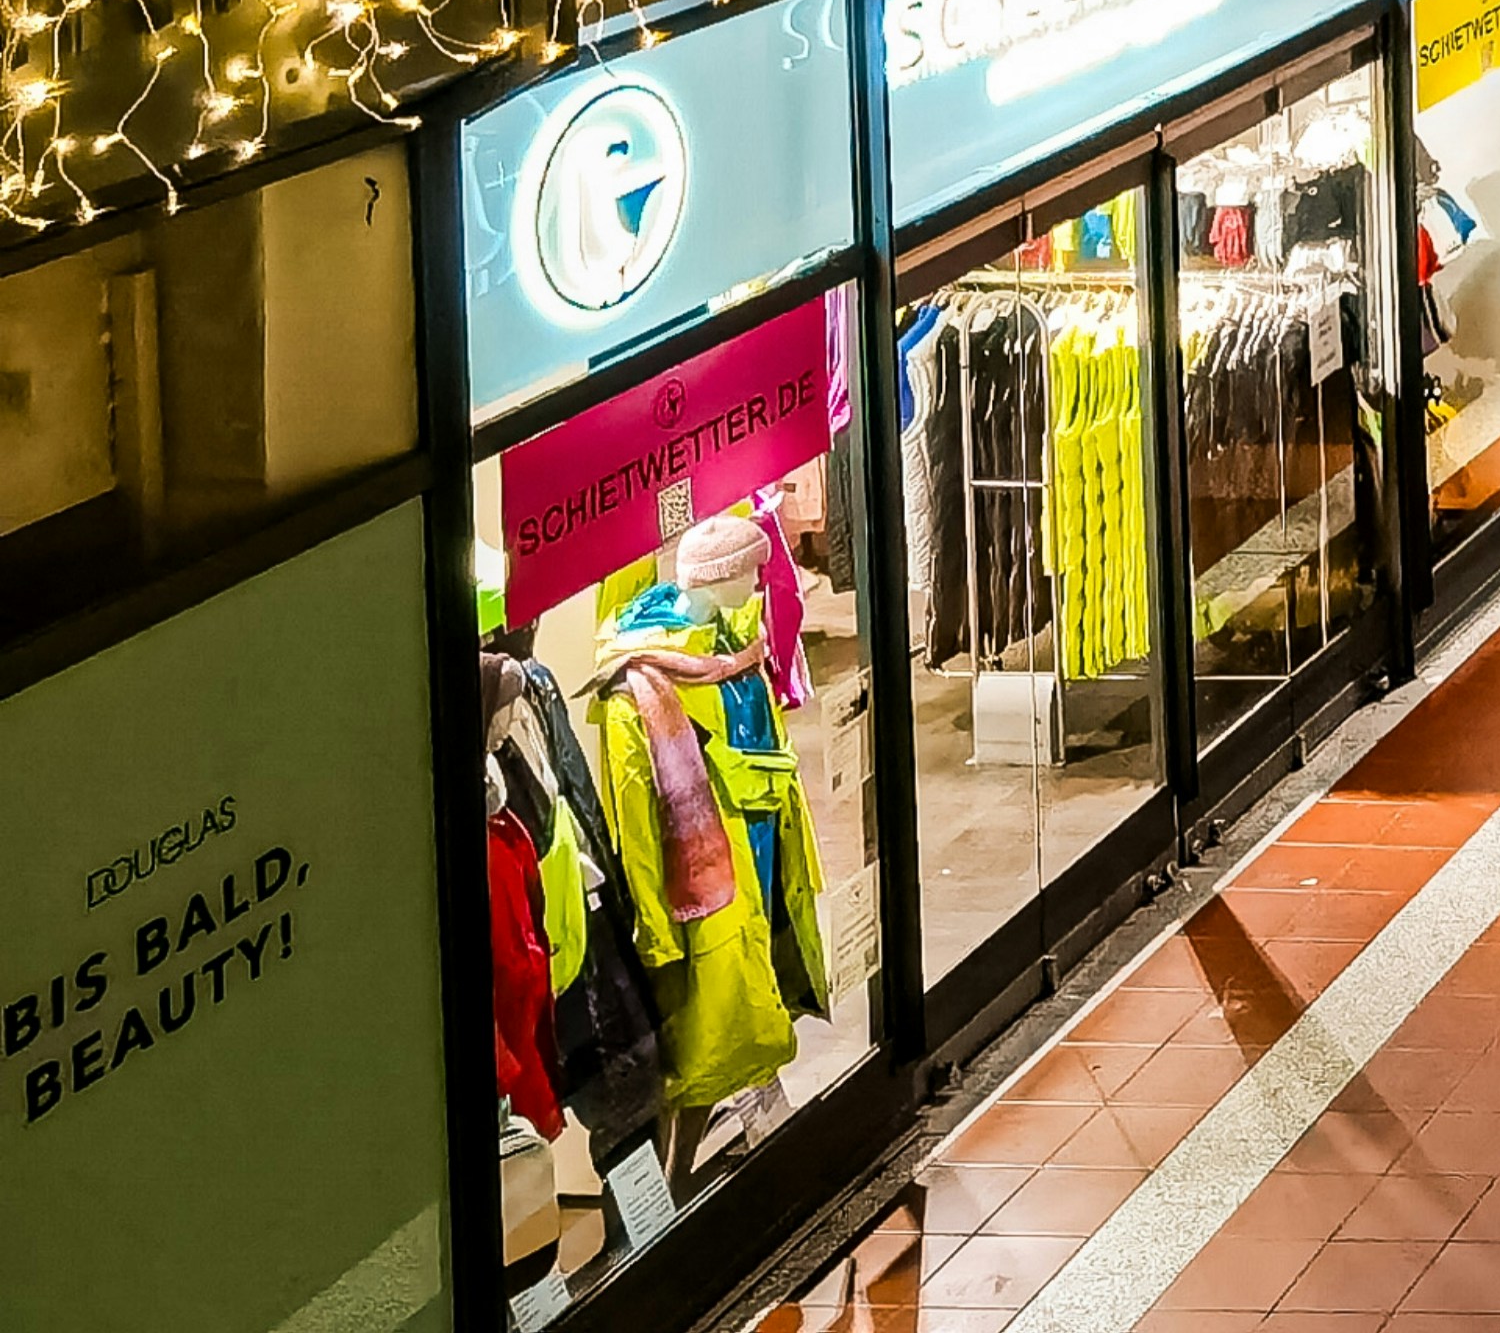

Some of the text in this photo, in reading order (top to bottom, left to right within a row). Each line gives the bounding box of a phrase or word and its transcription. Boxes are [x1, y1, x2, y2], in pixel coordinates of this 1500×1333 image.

[517, 368, 818, 558] SCHIETWETTER.DE
[3, 845, 311, 1058] BIS BALD,
[86, 795, 238, 911] DOUGLAS
[24, 911, 295, 1125] BEAUTY!
